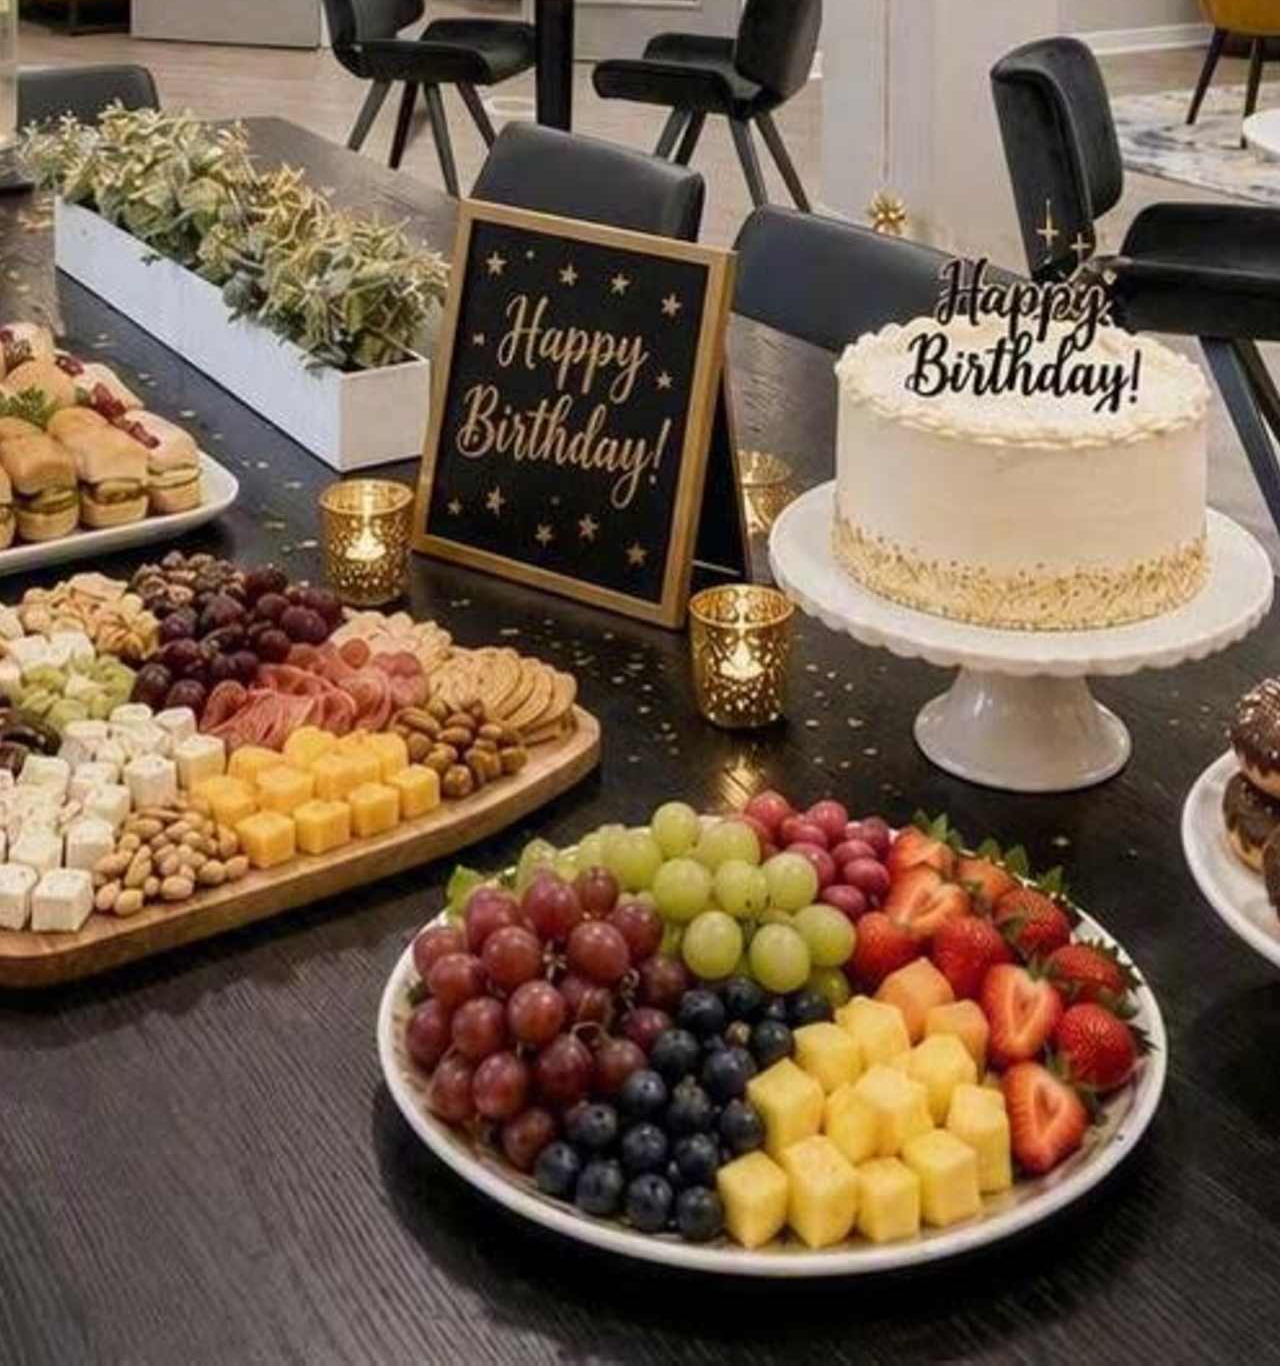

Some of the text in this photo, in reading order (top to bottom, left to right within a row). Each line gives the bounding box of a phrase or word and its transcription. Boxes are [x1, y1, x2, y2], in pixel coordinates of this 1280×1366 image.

[498, 295, 649, 403] Happy
[936, 258, 1111, 351] Happy
[905, 331, 1141, 413] Birthday!
[456, 385, 672, 509] Birthday!
